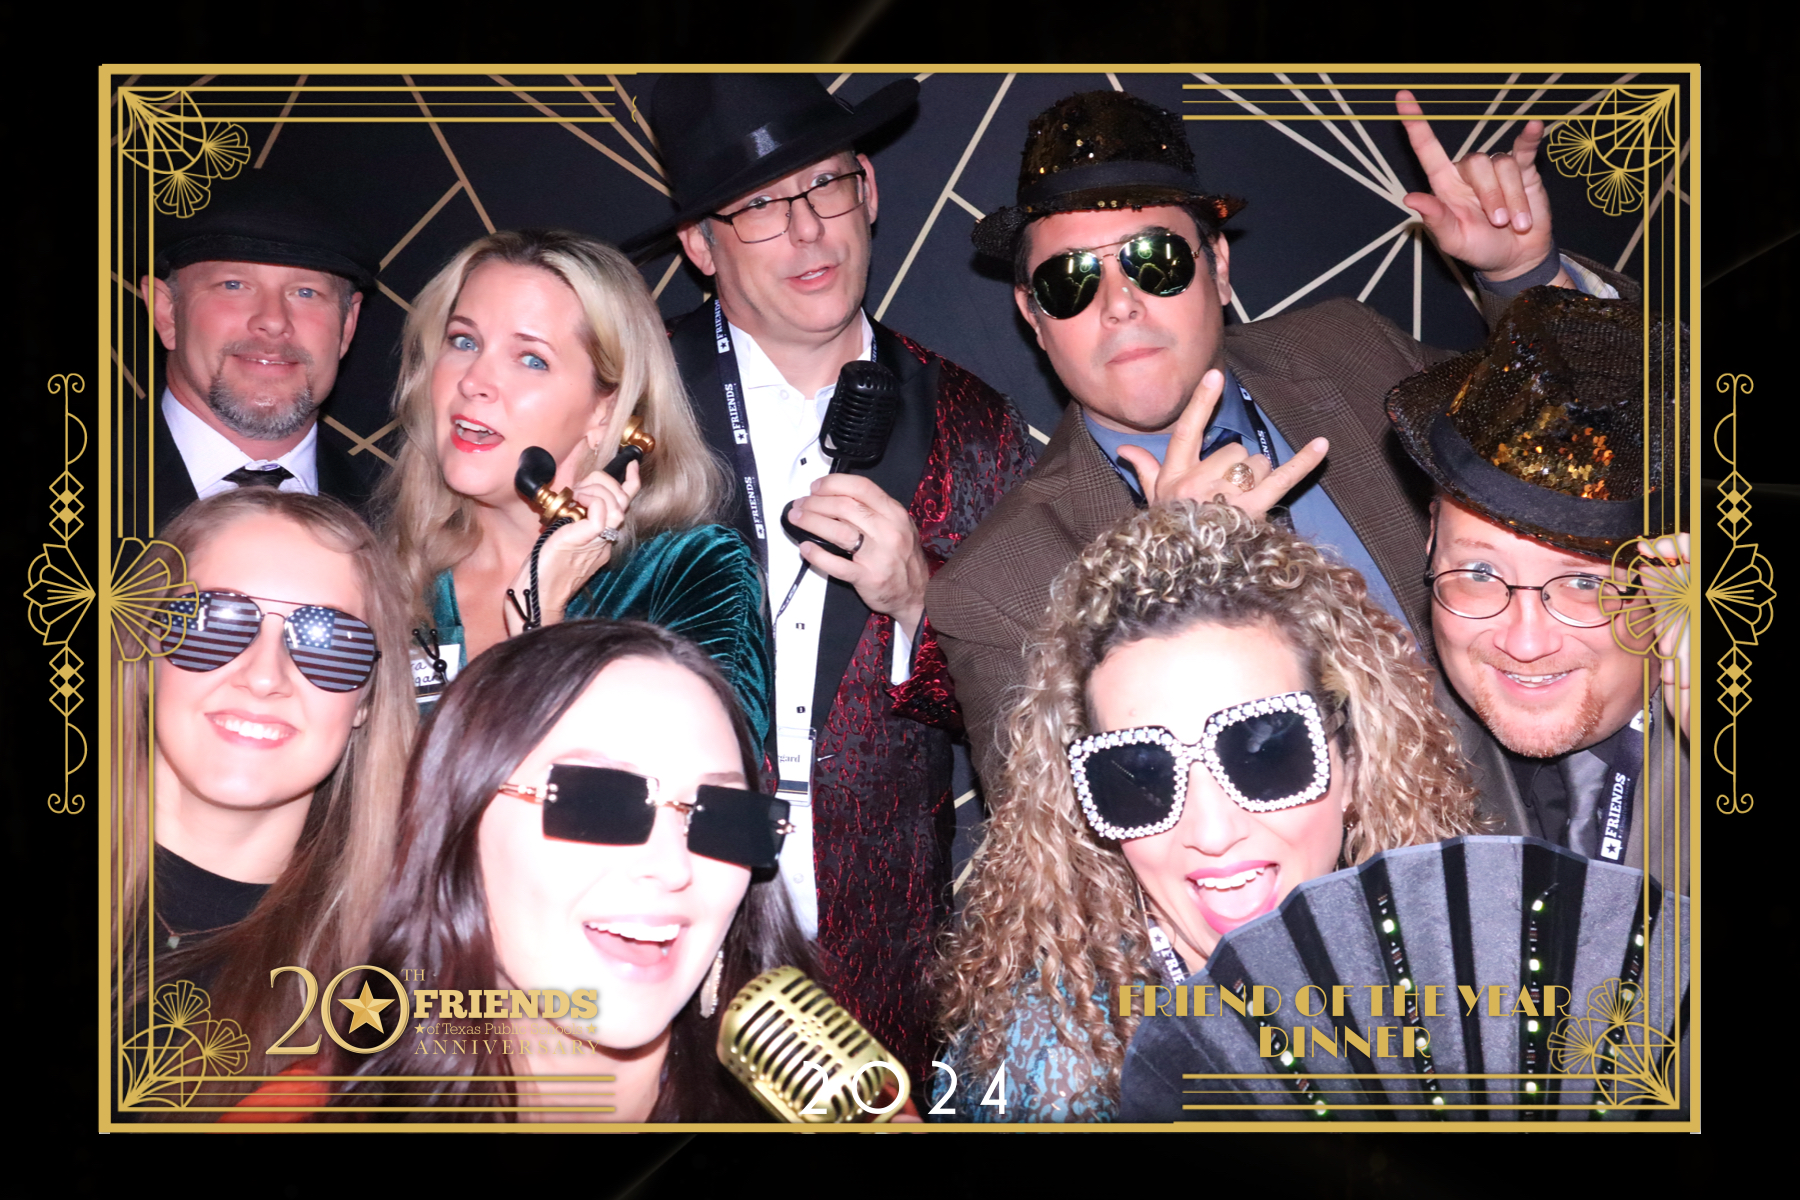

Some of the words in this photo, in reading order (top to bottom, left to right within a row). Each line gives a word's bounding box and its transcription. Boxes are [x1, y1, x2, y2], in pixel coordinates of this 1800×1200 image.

[724, 383, 741, 430] FRIENDS
[744, 476, 760, 524] FRIENDS
[1604, 772, 1626, 838] FRIENDS
